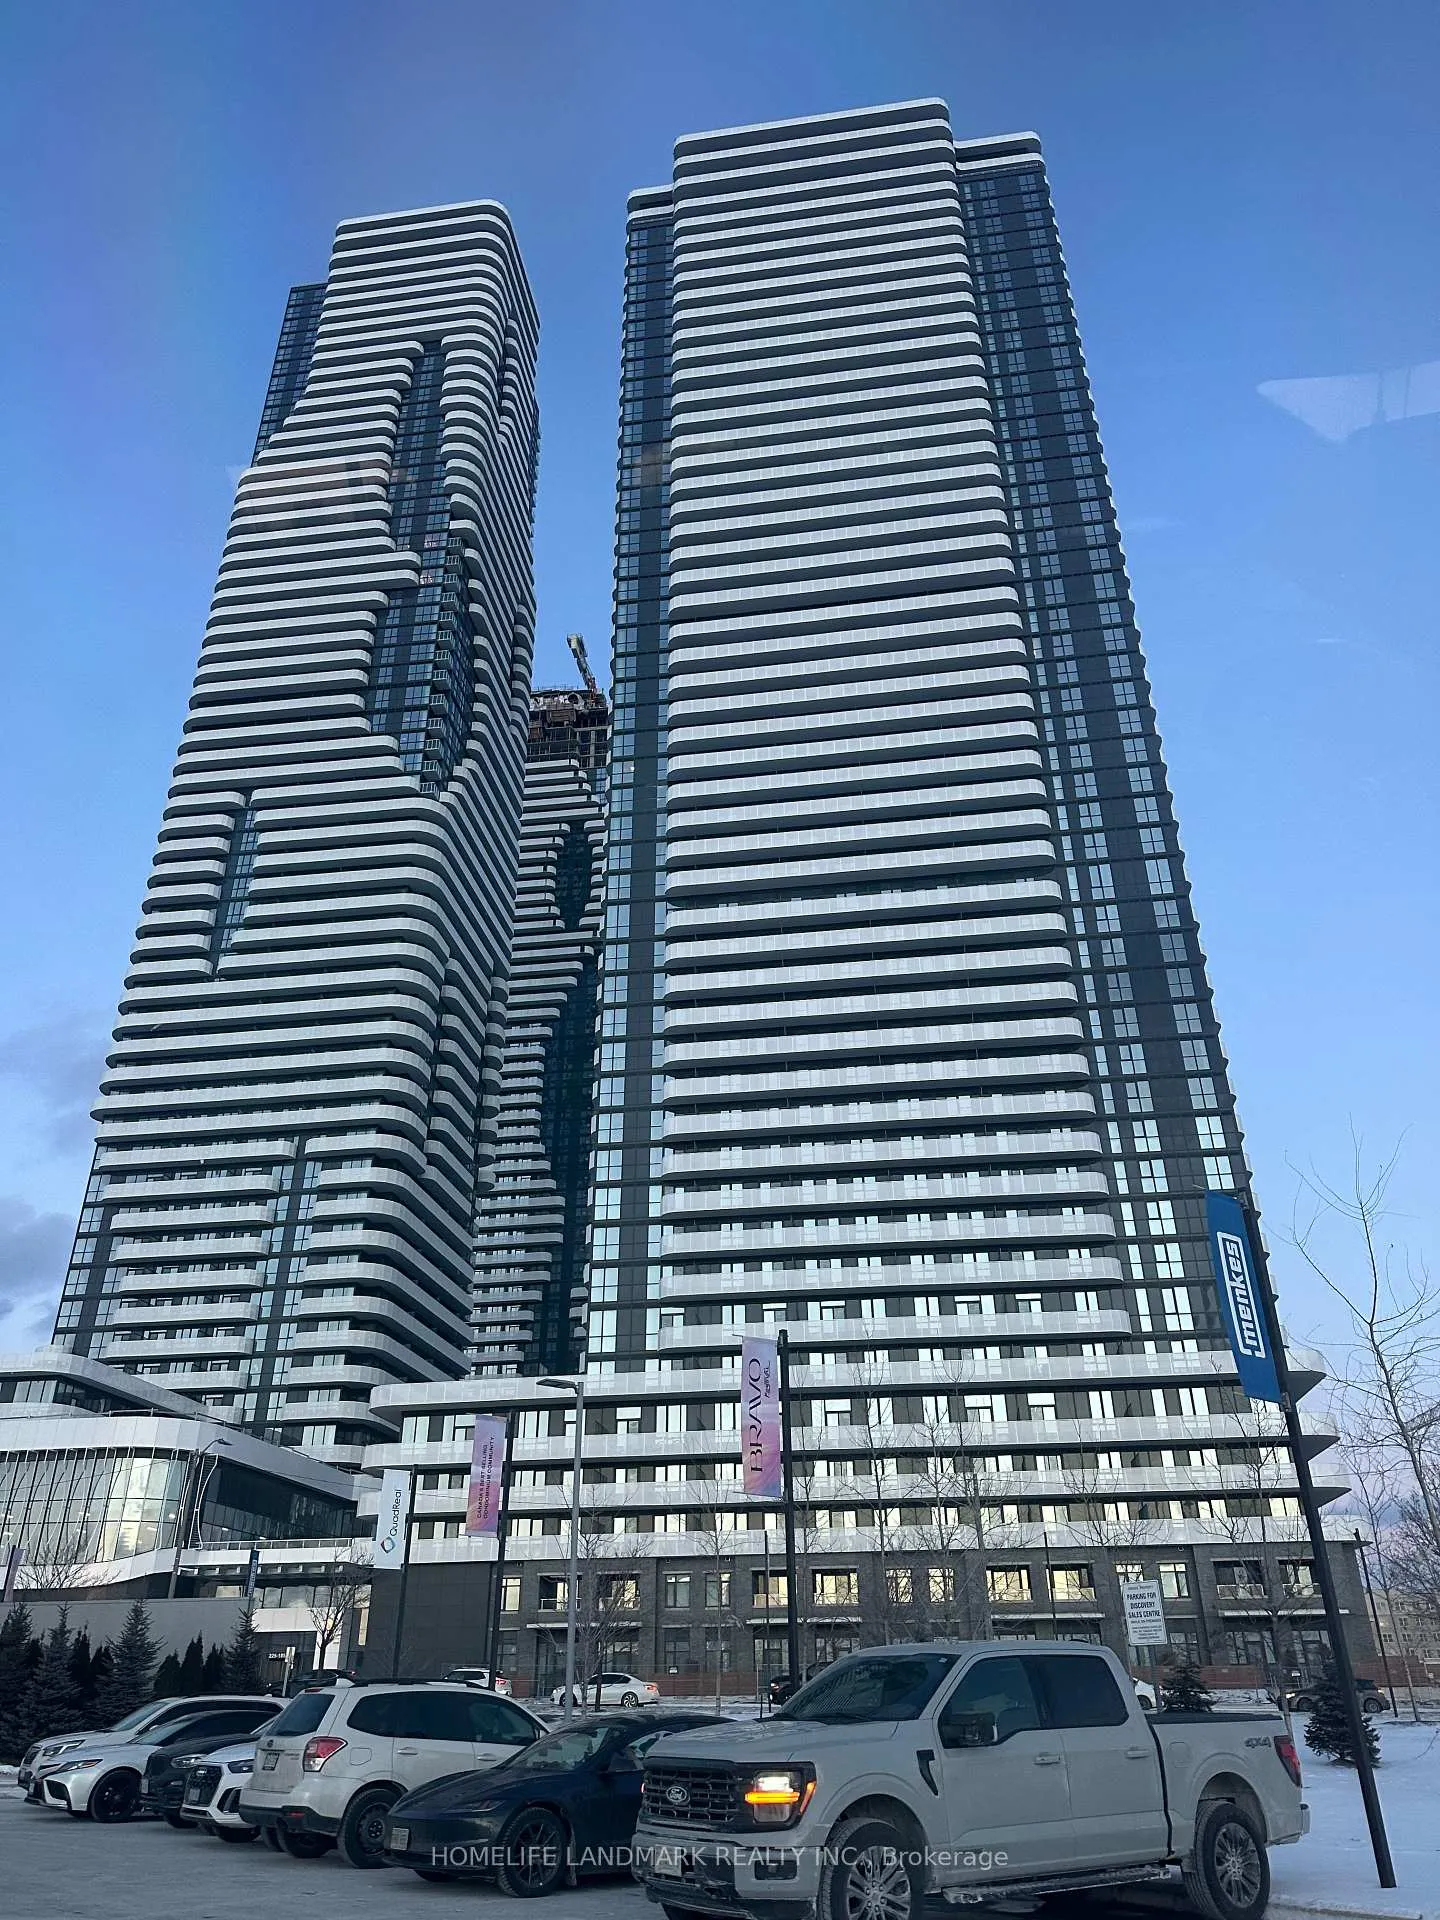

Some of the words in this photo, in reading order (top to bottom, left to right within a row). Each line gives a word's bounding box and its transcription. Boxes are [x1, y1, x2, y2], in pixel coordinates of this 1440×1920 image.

[1225, 1240, 1260, 1347] menkes
[749, 1358, 762, 1472] BRAVO
[389, 1489, 402, 1537] QuadReal
[1127, 1592, 1146, 1600] PARKING
[1130, 1601, 1155, 1609] DISCOVERY
